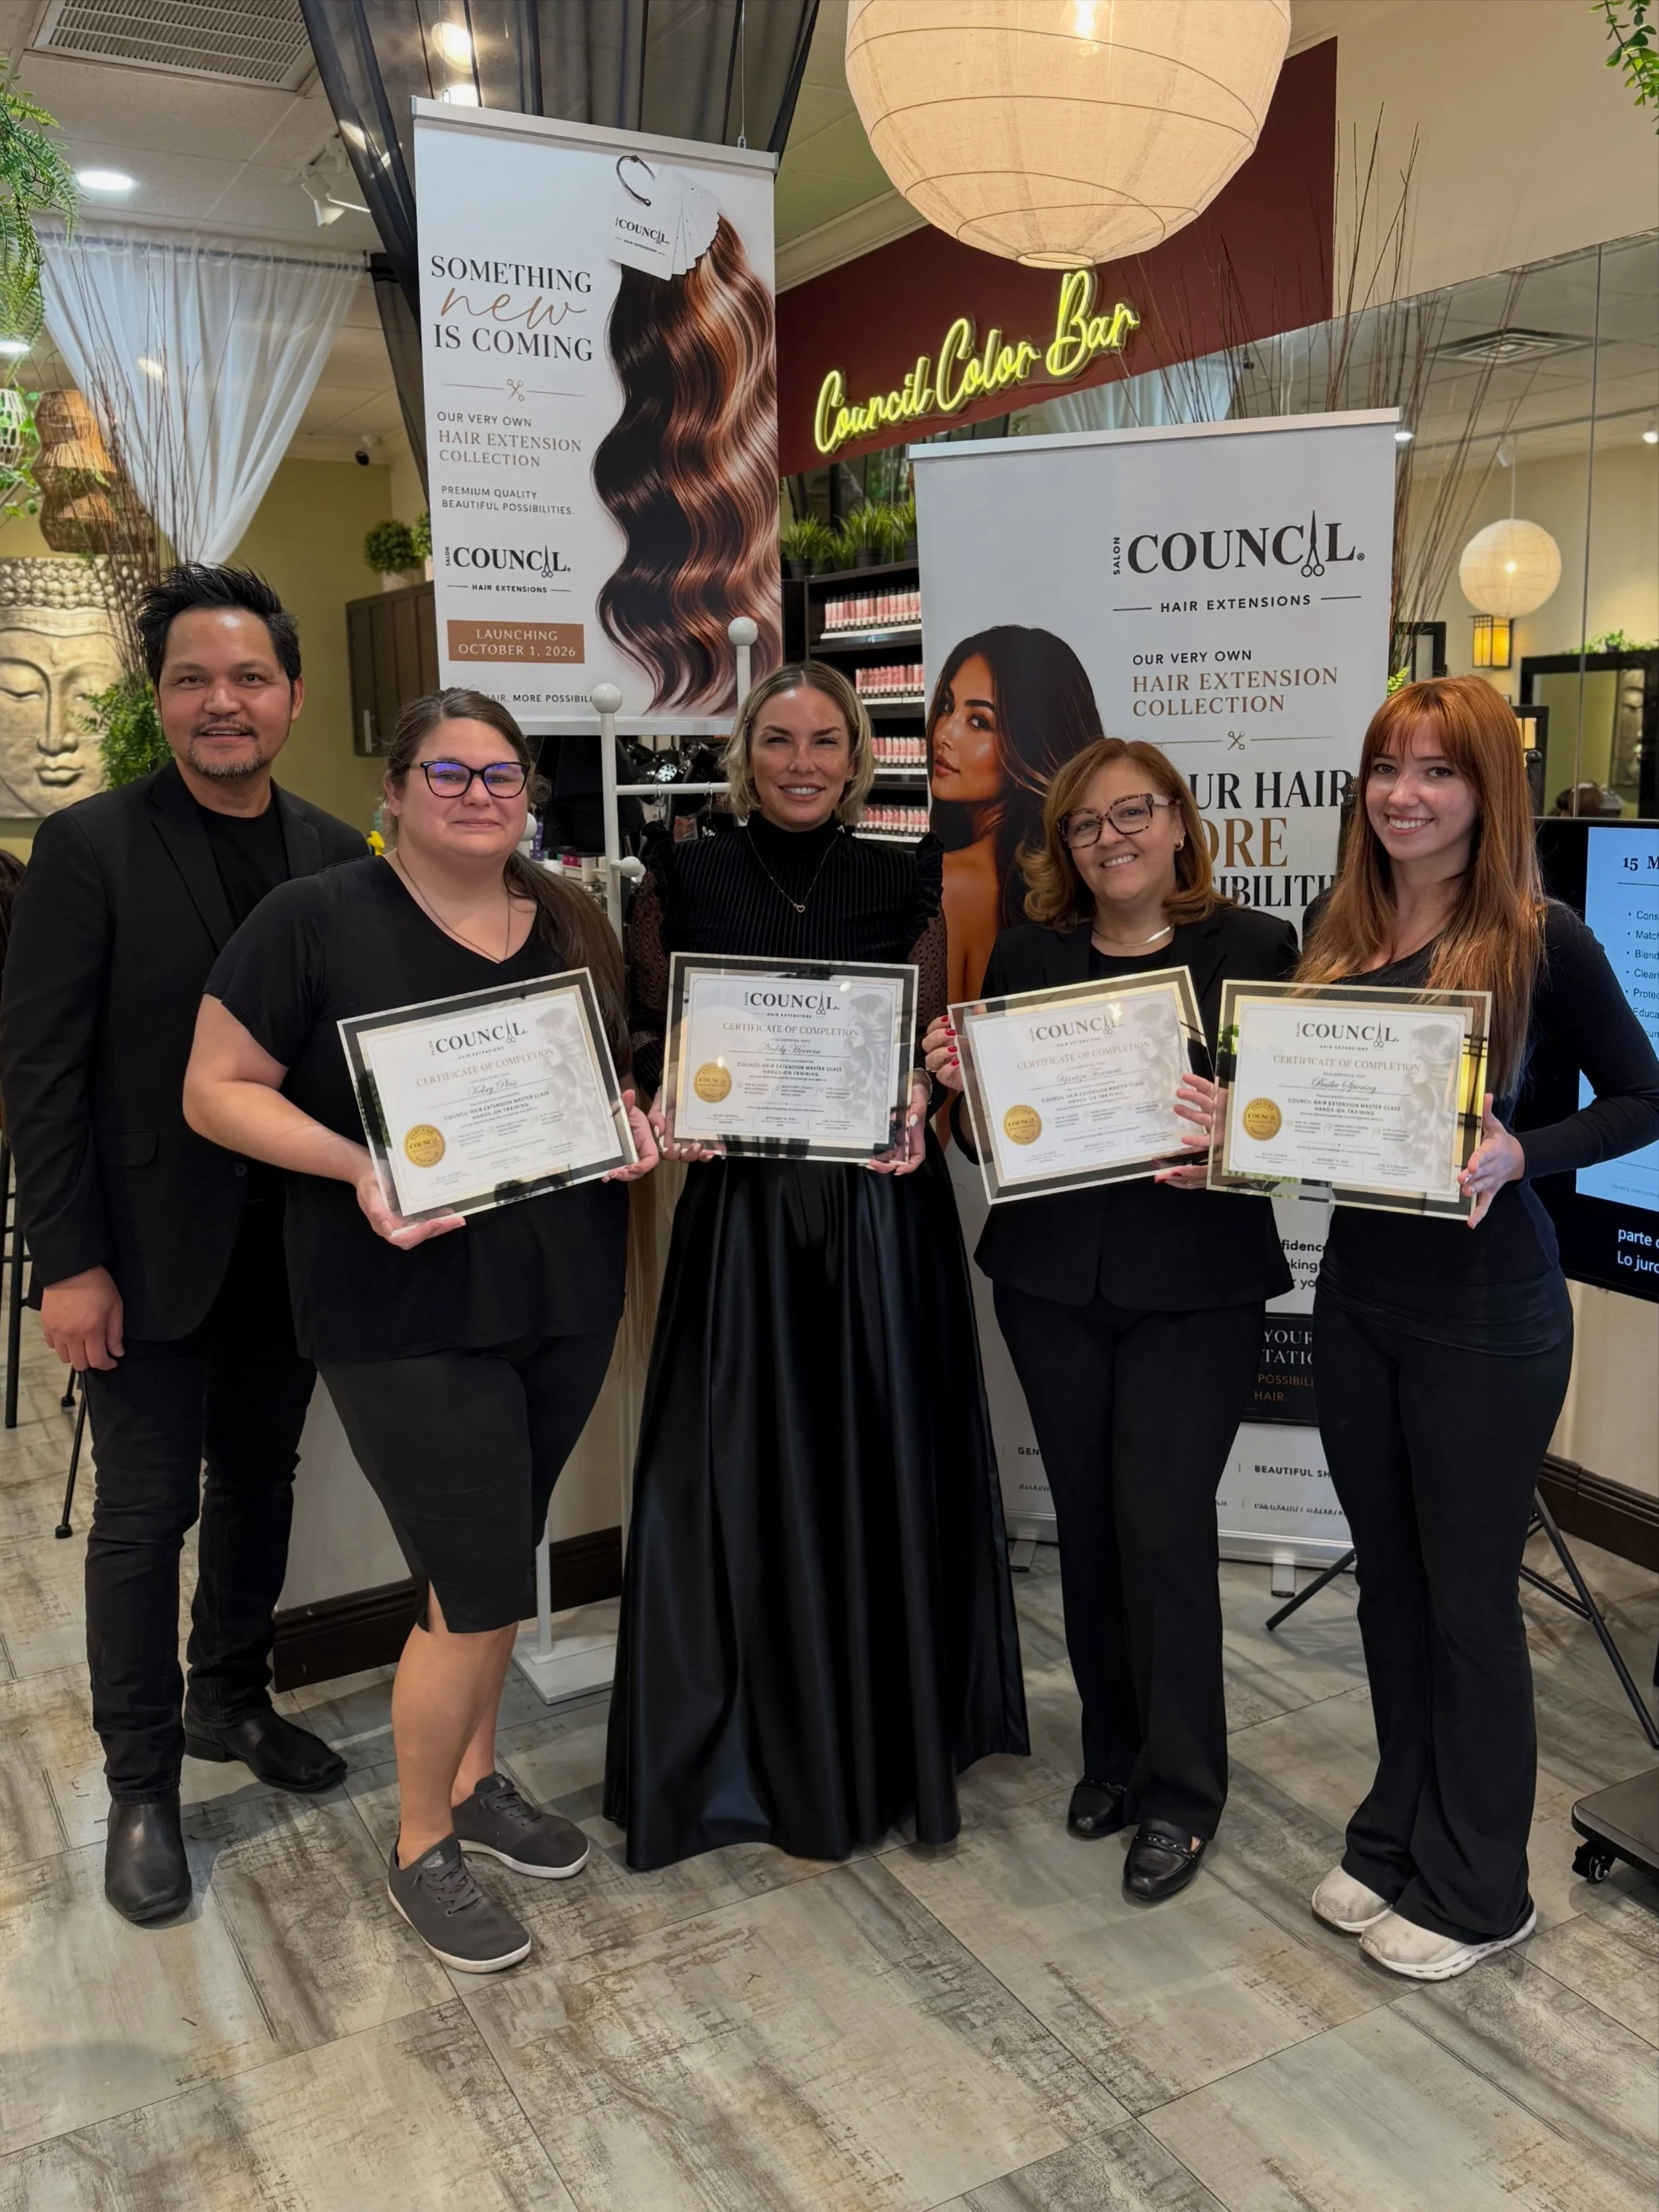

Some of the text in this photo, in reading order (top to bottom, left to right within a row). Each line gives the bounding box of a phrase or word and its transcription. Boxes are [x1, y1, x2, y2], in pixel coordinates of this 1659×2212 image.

[431, 256, 592, 293] SOMETHING
[441, 287, 587, 330] new
[433, 324, 593, 361] IS COMING
[814, 269, 1140, 454] Council Color Bar
[437, 411, 532, 427] OUR VERY OWN
[439, 430, 581, 452] HAIR EXTENSION
[439, 449, 540, 467] COLLECTION
[441, 485, 490, 496] PREMIUM
[442, 500, 499, 510] BEAUTIFUL
[496, 585, 547, 593] EXTENSIONS
[1161, 595, 1311, 613] HAIR EXTENSIONS
[476, 628, 557, 641] LAUNCHING
[459, 644, 524, 656] OCTOBER
[545, 646, 576, 656] 2026
[1133, 650, 1252, 665] OUR VERY OWN
[1133, 667, 1338, 693] HAIR EXTENSION
[487, 694, 510, 702] AIR.
[545, 694, 593, 703] POSSIBILI
[1133, 695, 1285, 717] COLLECTION
[1189, 770, 1352, 810] UR HAIR
[1623, 857, 1638, 871] 15
[1636, 911, 1659, 921] Cons
[1635, 950, 1659, 960] Blend
[1634, 968, 1659, 979] Clean
[723, 1022, 782, 1033] CERTIFICATE
[799, 1026, 859, 1037] COMPLETION
[1017, 1054, 1076, 1070] CERTIFICATE
[1078, 1051, 1089, 1060] OF
[1092, 1041, 1150, 1057] COMPLETION
[1273, 1055, 1336, 1067] CERTIFICATE
[1354, 1060, 1420, 1071] COMPLETION
[417, 1065, 479, 1086] CERTIFICATE
[481, 1062, 493, 1072] OF
[496, 1048, 554, 1068] COMPLETION
[1618, 1228, 1652, 1246] parte
[1291, 1258, 1318, 1274] king
[1617, 1250, 1632, 1266] Lo
[1018, 1447, 1039, 1455] GEN
[1255, 1465, 1331, 1478] BEAUTIFUL SH
